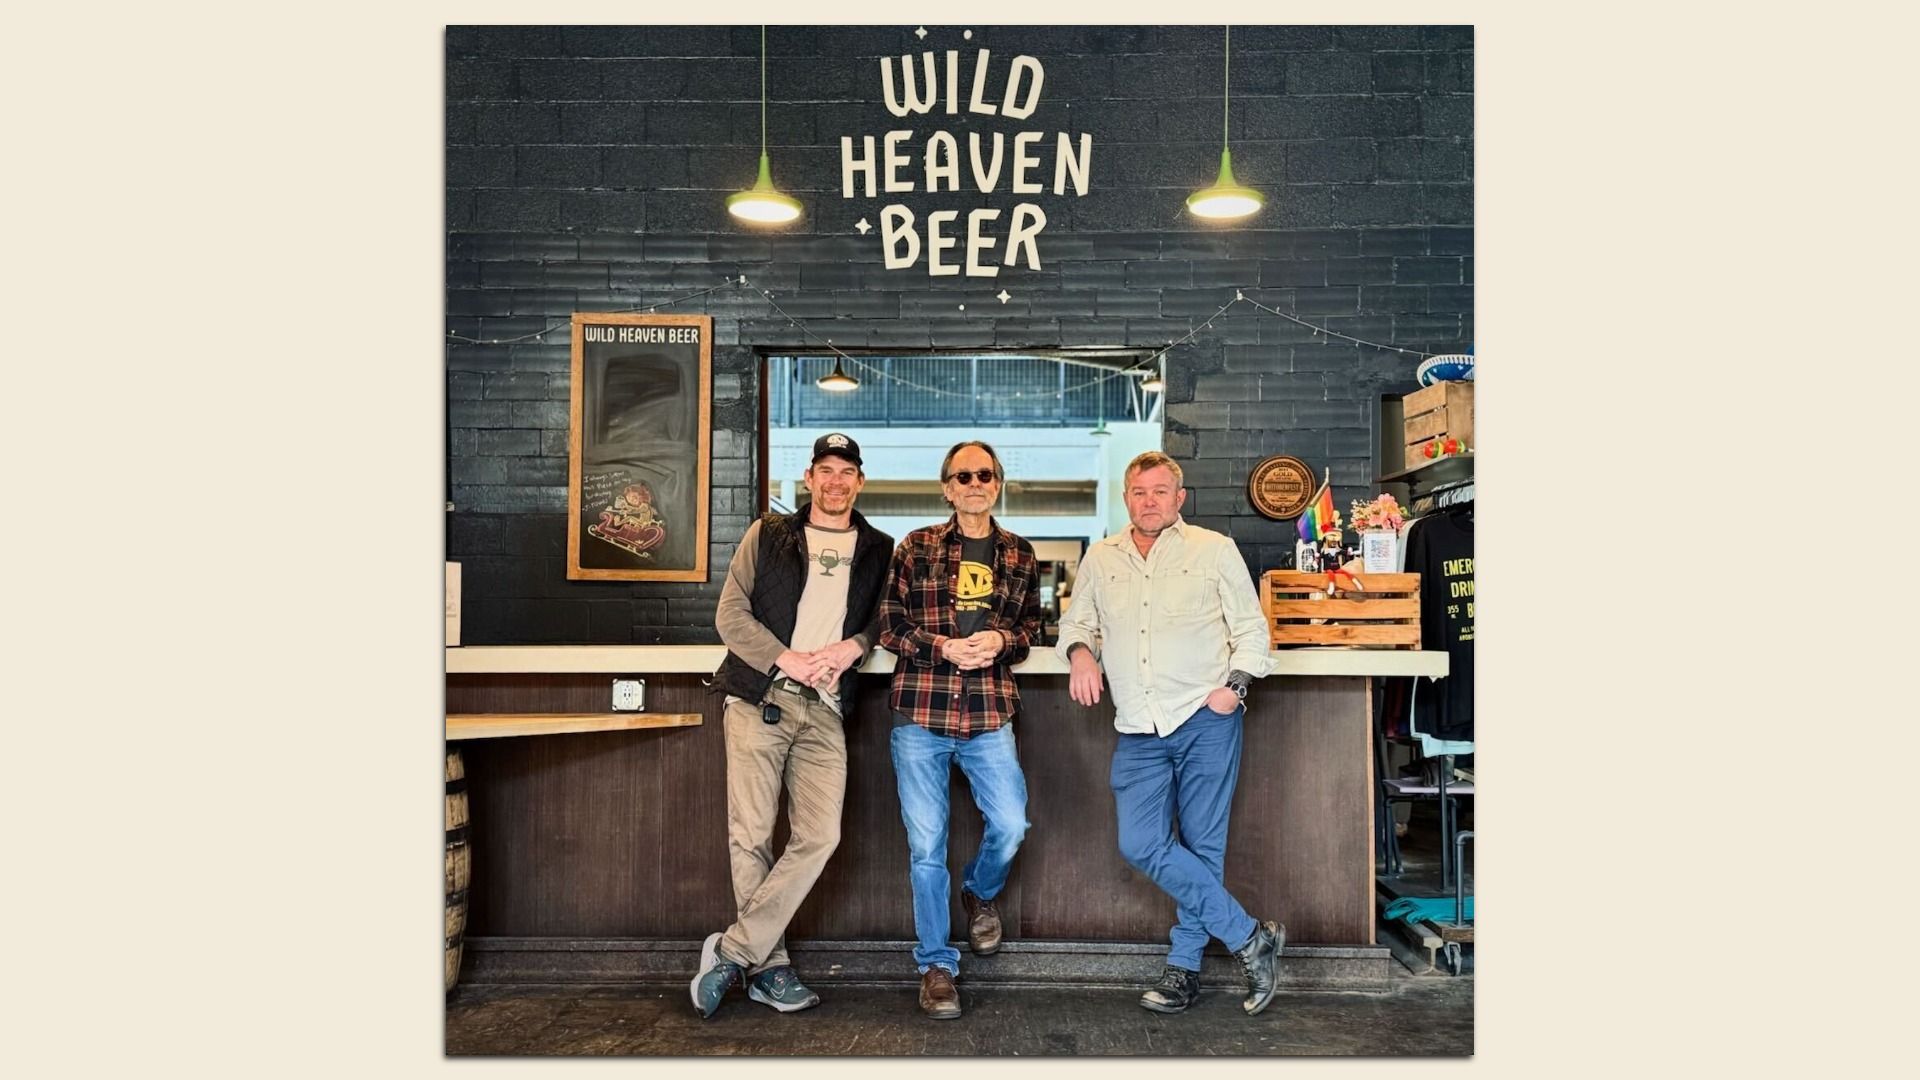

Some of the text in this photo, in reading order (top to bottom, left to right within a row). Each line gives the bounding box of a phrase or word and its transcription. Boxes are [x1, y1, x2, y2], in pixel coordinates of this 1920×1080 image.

[880, 48, 1045, 120] WILD
[841, 130, 1092, 198] HEAVEN
[880, 202, 1047, 277] BEER
[585, 327, 699, 344] WILD HEAVEN BEER
[1447, 604, 1459, 614] 355
